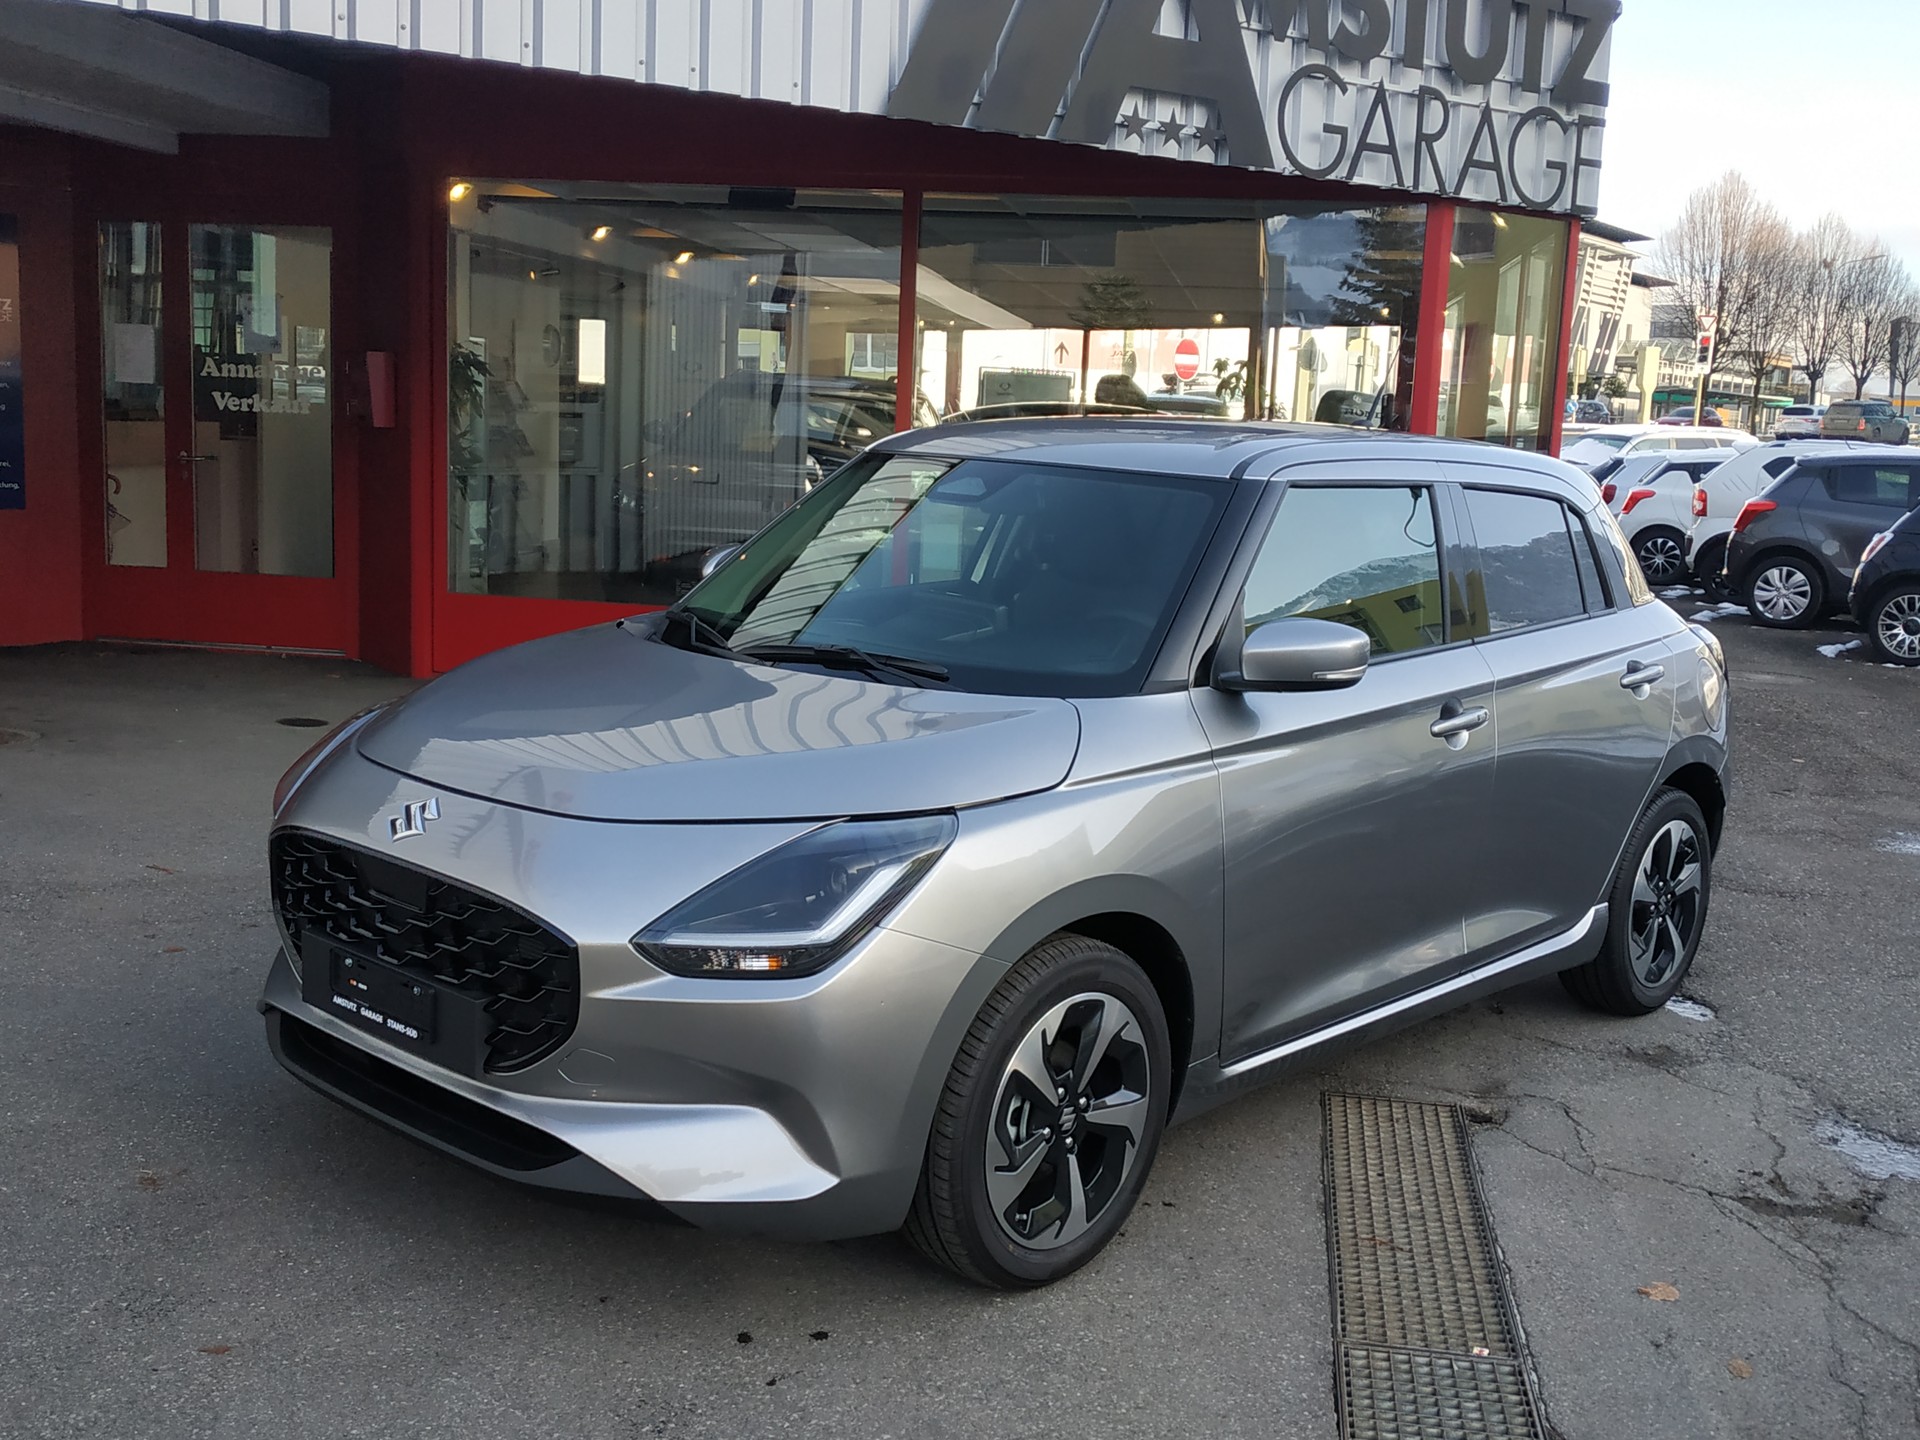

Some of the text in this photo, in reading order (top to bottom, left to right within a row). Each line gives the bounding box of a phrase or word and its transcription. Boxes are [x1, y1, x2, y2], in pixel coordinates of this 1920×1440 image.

[1277, 63, 1606, 216] GARAGE
[200, 356, 324, 379] Annahme
[211, 391, 311, 414] Verkauf
[333, 995, 357, 1012] AMSTUTZ
[360, 1007, 383, 1023] GARAGE
